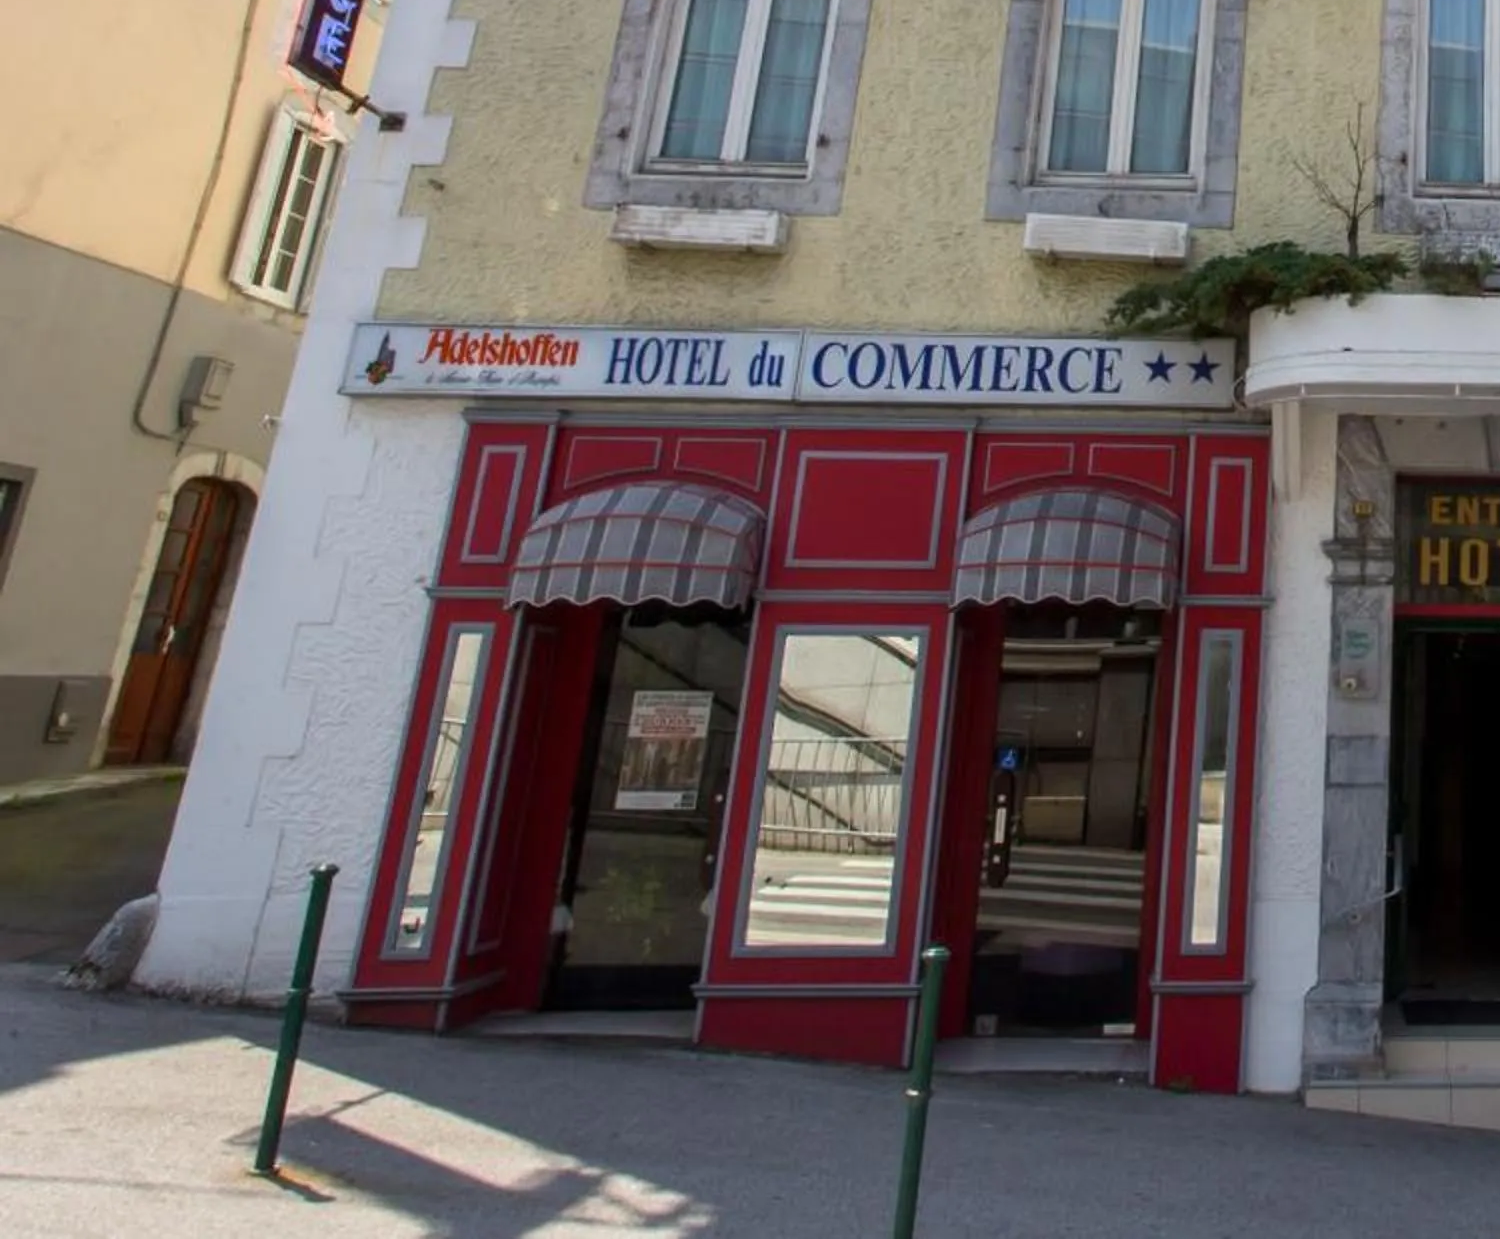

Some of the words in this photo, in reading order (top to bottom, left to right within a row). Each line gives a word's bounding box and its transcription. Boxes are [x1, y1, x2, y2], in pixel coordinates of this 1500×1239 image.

[417, 328, 579, 367] Adelshoffen
[604, 337, 730, 387] HOTEL
[748, 341, 785, 388] du
[812, 341, 1123, 394] COMMERCE
